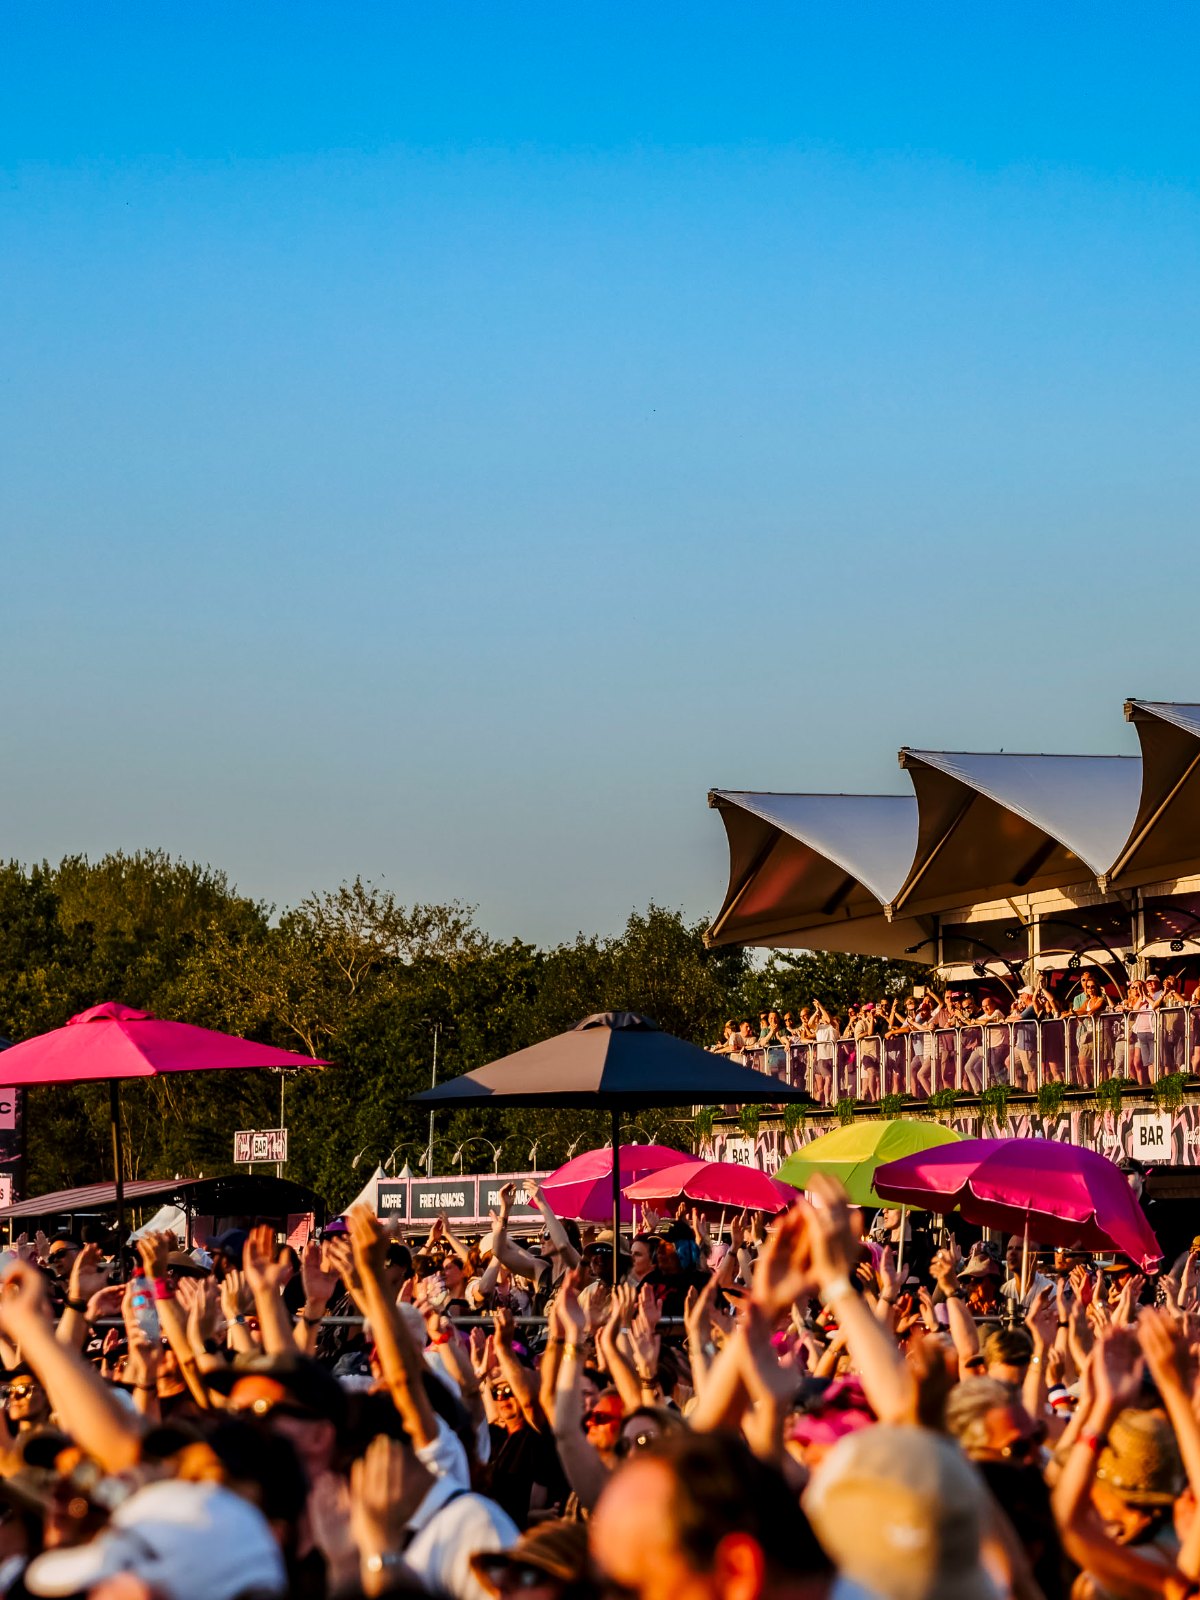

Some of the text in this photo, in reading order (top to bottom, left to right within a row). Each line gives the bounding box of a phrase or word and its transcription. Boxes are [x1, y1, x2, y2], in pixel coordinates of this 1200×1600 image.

[1140, 1126, 1163, 1145] BAR
[255, 1140, 267, 1153] BAR
[732, 1148, 750, 1164] BAR
[381, 1194, 401, 1208] KOFFIE
[420, 1193, 435, 1208] FRIET
[440, 1192, 464, 1207] SNACKS
